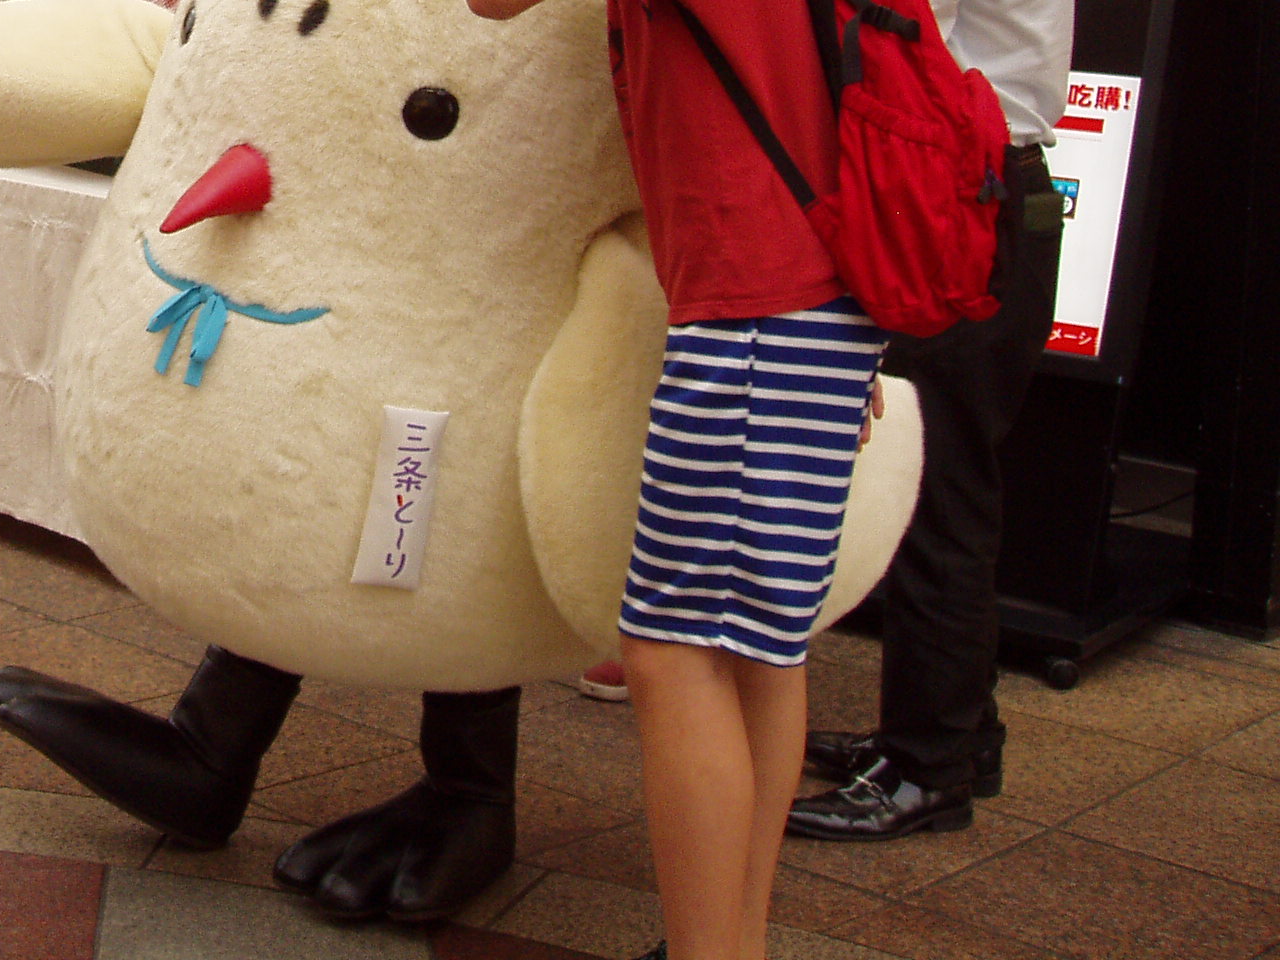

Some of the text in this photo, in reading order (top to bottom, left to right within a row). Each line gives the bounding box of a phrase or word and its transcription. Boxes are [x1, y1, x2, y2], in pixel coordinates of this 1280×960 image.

[384, 422, 430, 579] 三条とーり
